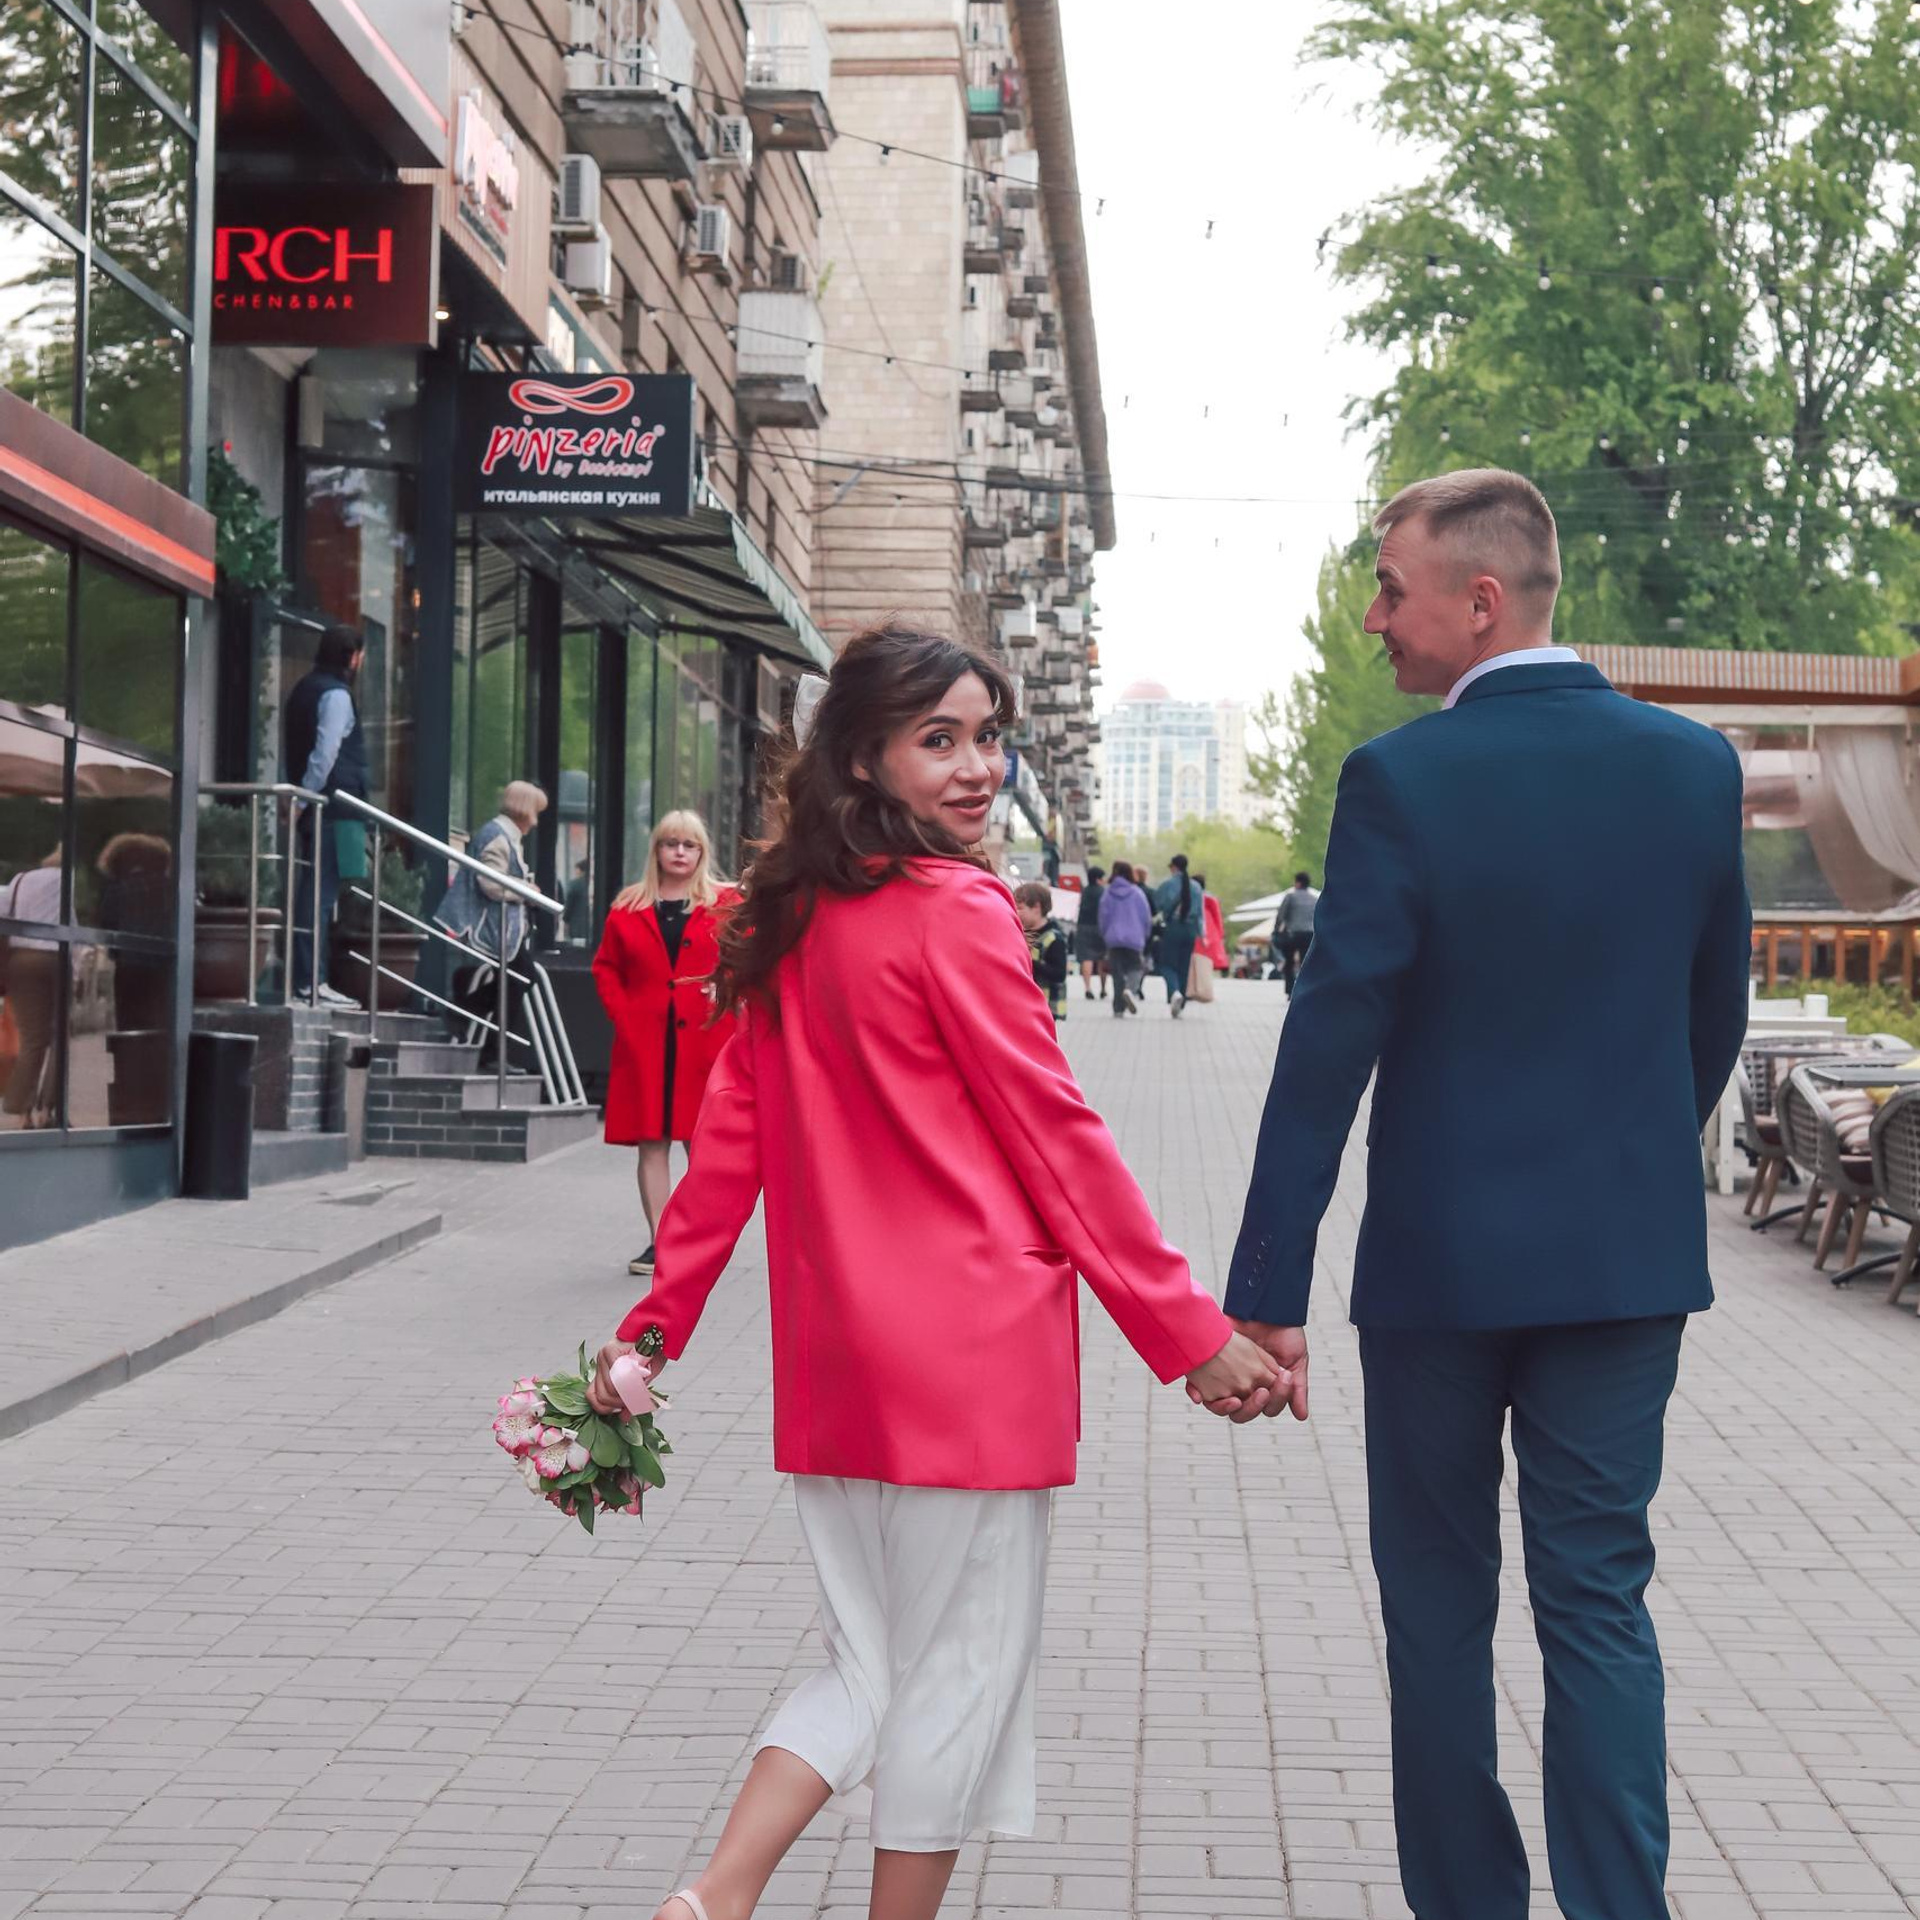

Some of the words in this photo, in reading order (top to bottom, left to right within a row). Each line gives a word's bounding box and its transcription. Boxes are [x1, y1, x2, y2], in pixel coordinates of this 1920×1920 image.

[553, 460, 574, 478] by
[483, 490, 603, 504] итальянская
[606, 491, 660, 507] кухня
